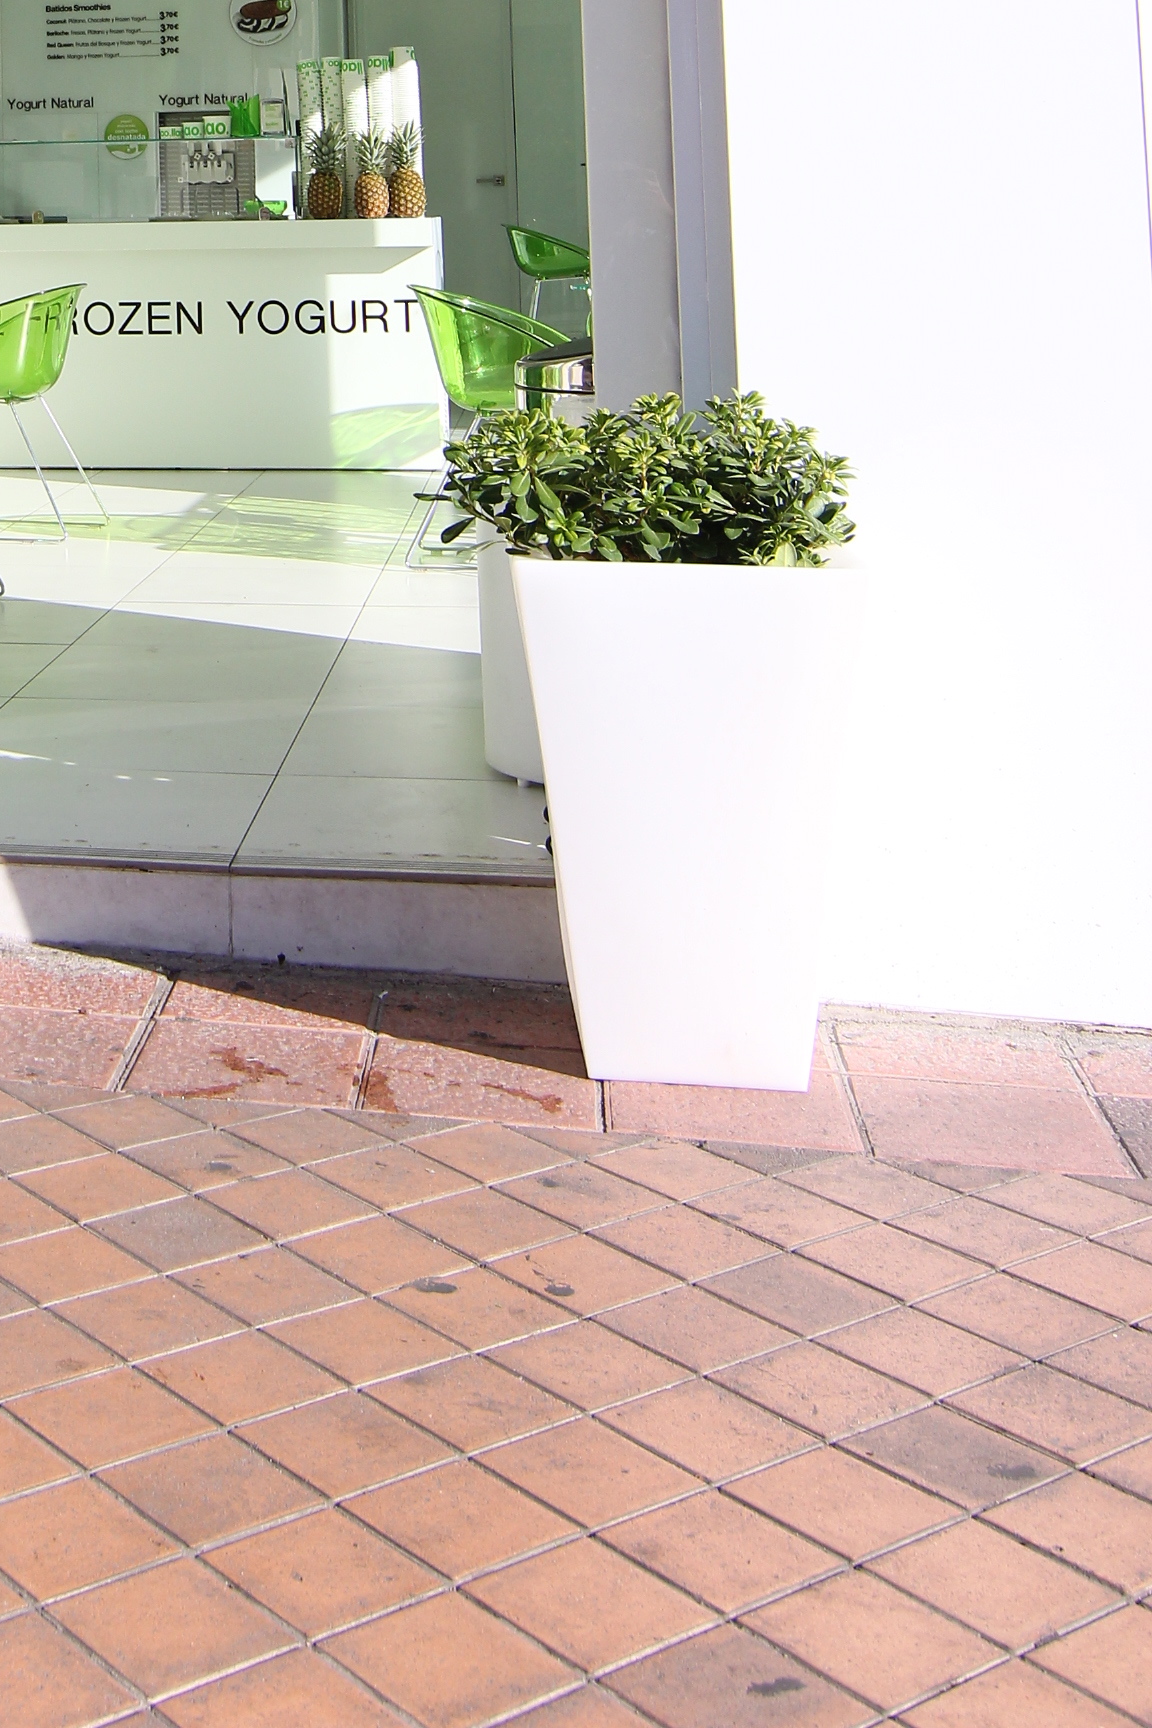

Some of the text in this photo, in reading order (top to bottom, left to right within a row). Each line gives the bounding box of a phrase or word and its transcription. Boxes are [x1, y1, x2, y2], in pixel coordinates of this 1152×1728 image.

[74, 4, 111, 12] Smoothies
[7, 96, 94, 112] Yogurt Natural
[158, 92, 248, 108] Yogurt Natural
[227, 297, 420, 336] YOGURT
